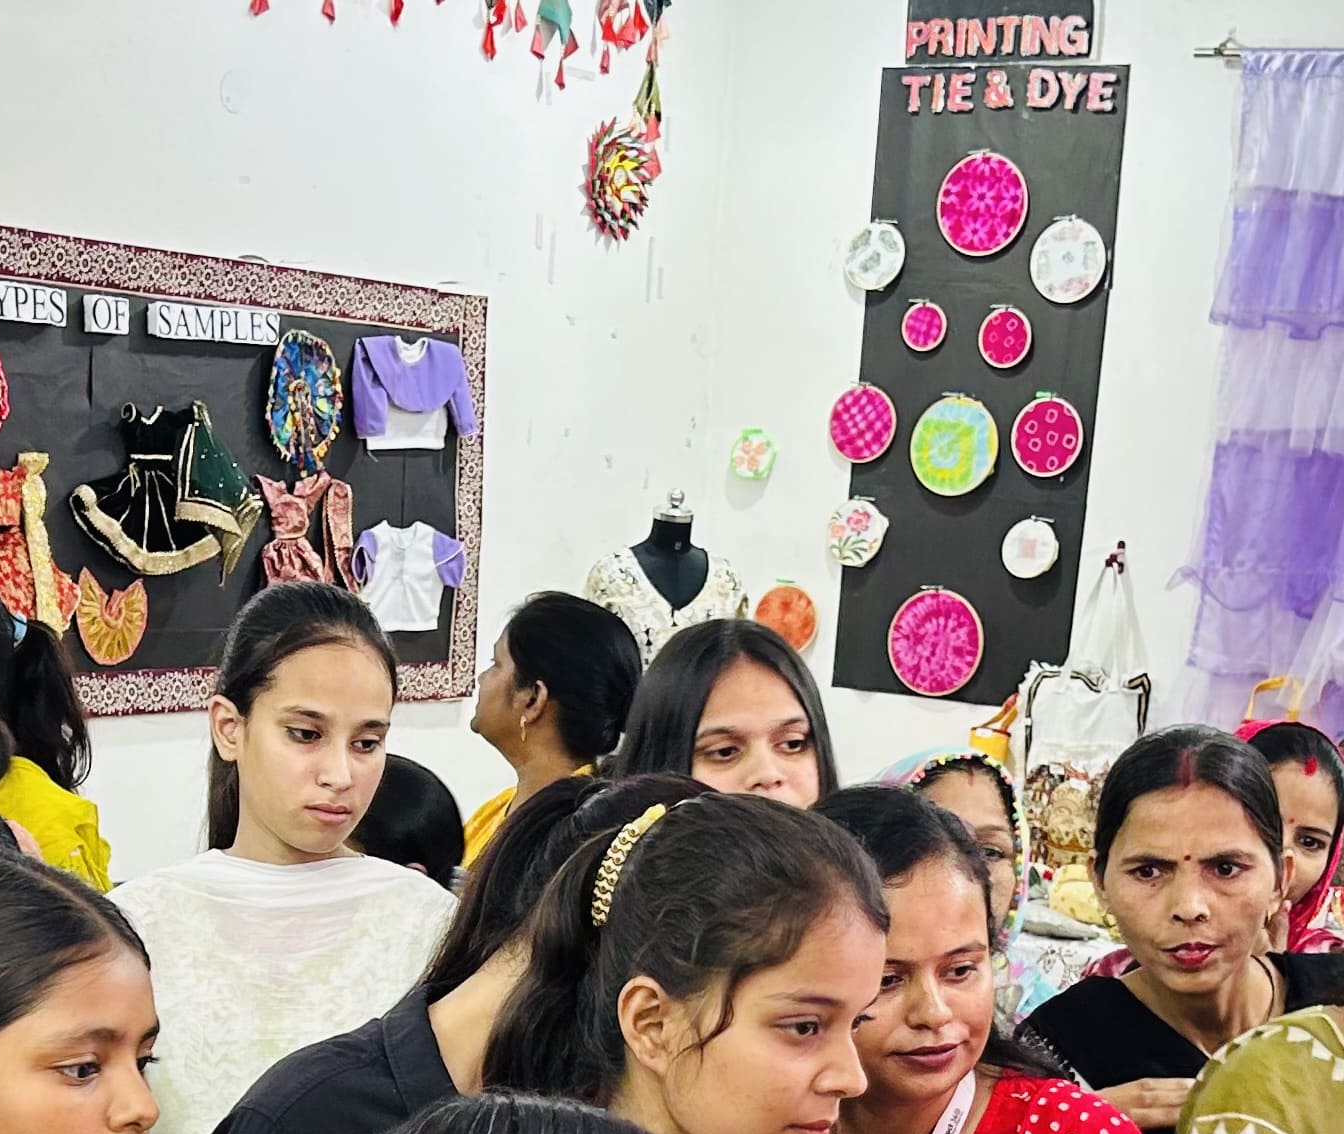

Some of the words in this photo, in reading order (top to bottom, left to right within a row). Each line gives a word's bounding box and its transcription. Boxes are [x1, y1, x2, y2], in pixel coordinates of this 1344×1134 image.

[906, 15, 1090, 58] PRINTING
[901, 72, 977, 113] TIE
[983, 69, 1015, 109] &
[1025, 67, 1118, 112] DYE
[92, 297, 130, 331] OF
[158, 303, 280, 344] SAMPLES
